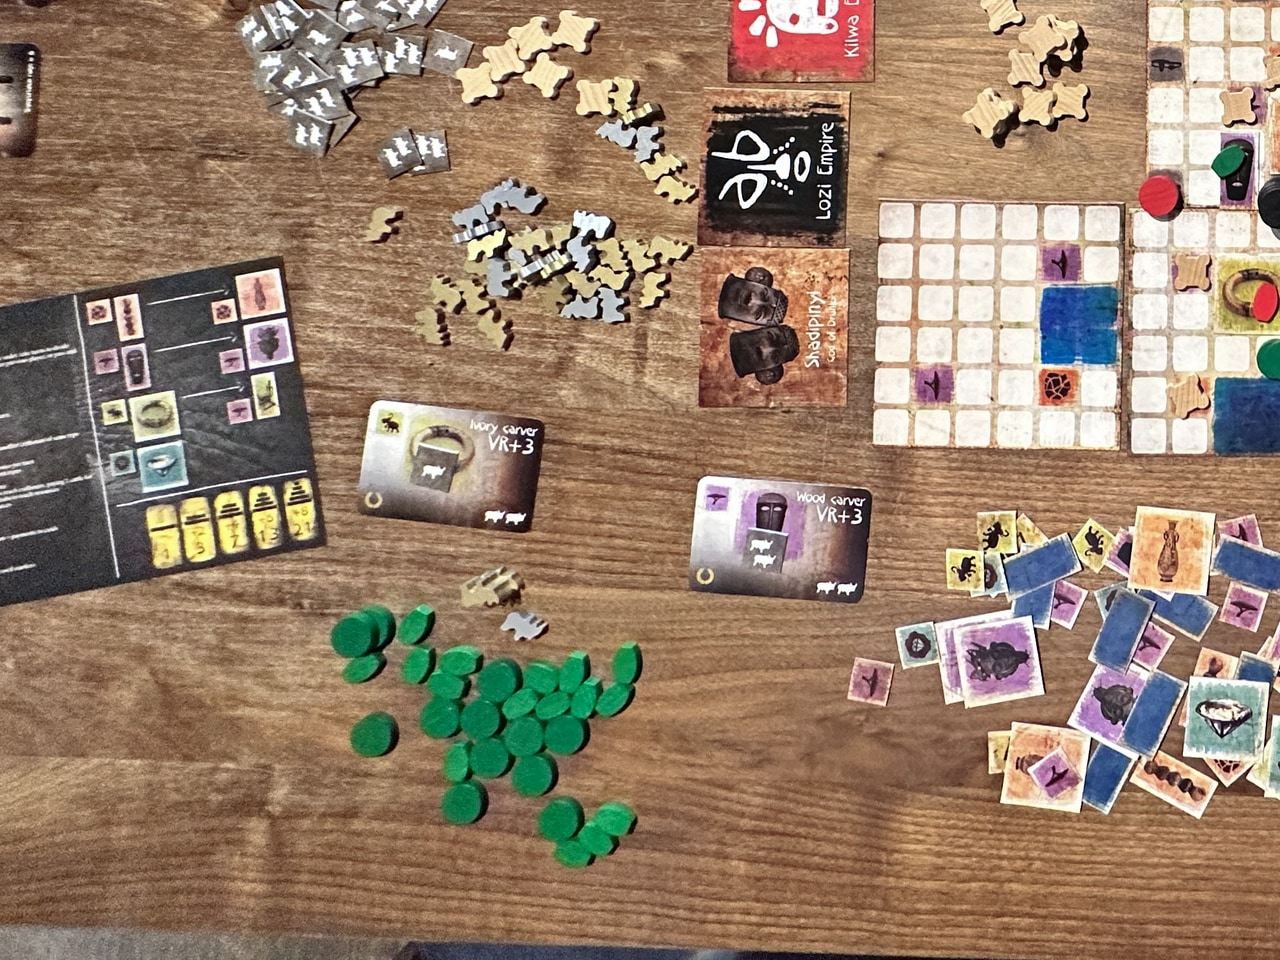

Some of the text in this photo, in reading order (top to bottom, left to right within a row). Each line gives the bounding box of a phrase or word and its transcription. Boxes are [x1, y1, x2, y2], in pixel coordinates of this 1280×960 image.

[844, 16, 860, 59] Kilwa
[815, 122, 837, 220] Lozi Empire
[469, 419, 539, 437] Ivory carver
[488, 434, 534, 455] VR+3
[796, 491, 866, 507] Wood carver
[816, 505, 863, 525] VR+3
